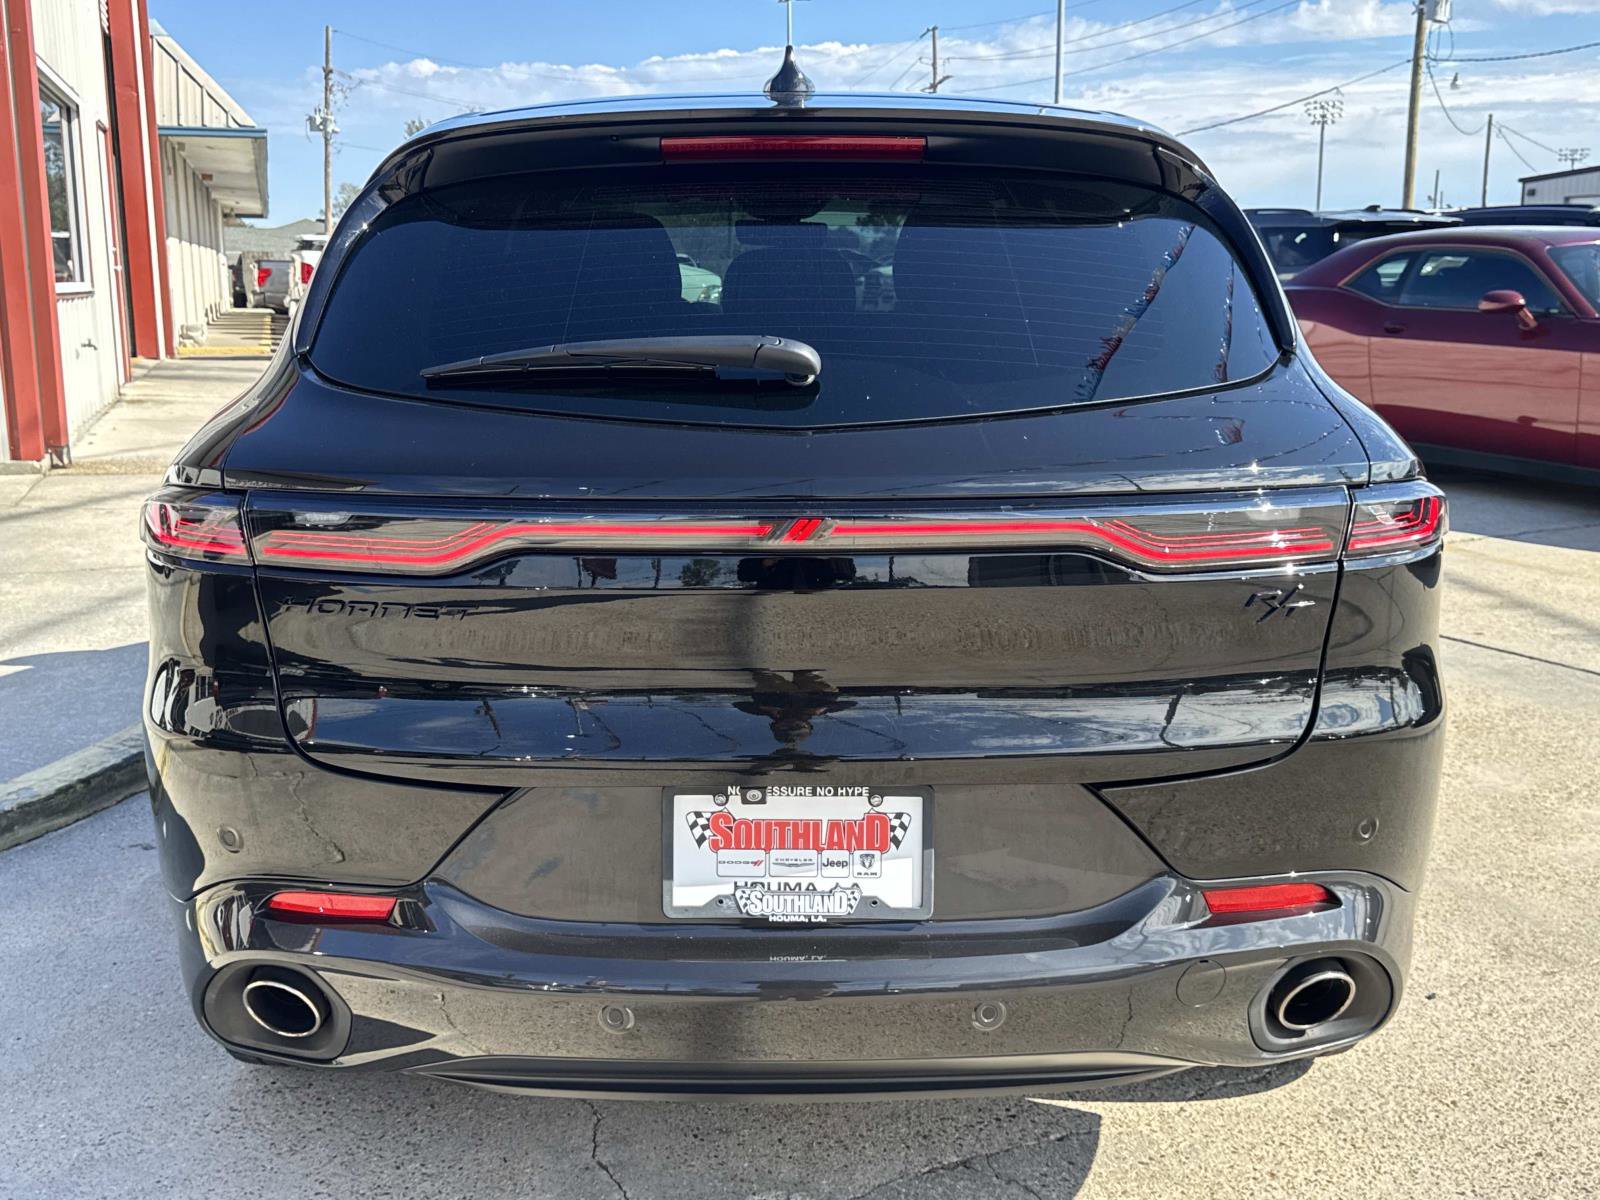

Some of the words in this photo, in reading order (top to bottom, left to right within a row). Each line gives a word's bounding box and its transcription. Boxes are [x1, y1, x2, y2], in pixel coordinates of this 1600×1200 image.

[281, 596, 479, 621] HORNET
[766, 786, 813, 797] ESSURE
[816, 786, 834, 797] NO
[837, 786, 870, 797] HYPE
[710, 811, 891, 854] SOUTHLAND
[822, 857, 849, 869] Jeep
[748, 890, 849, 915] SOUTHLAND
